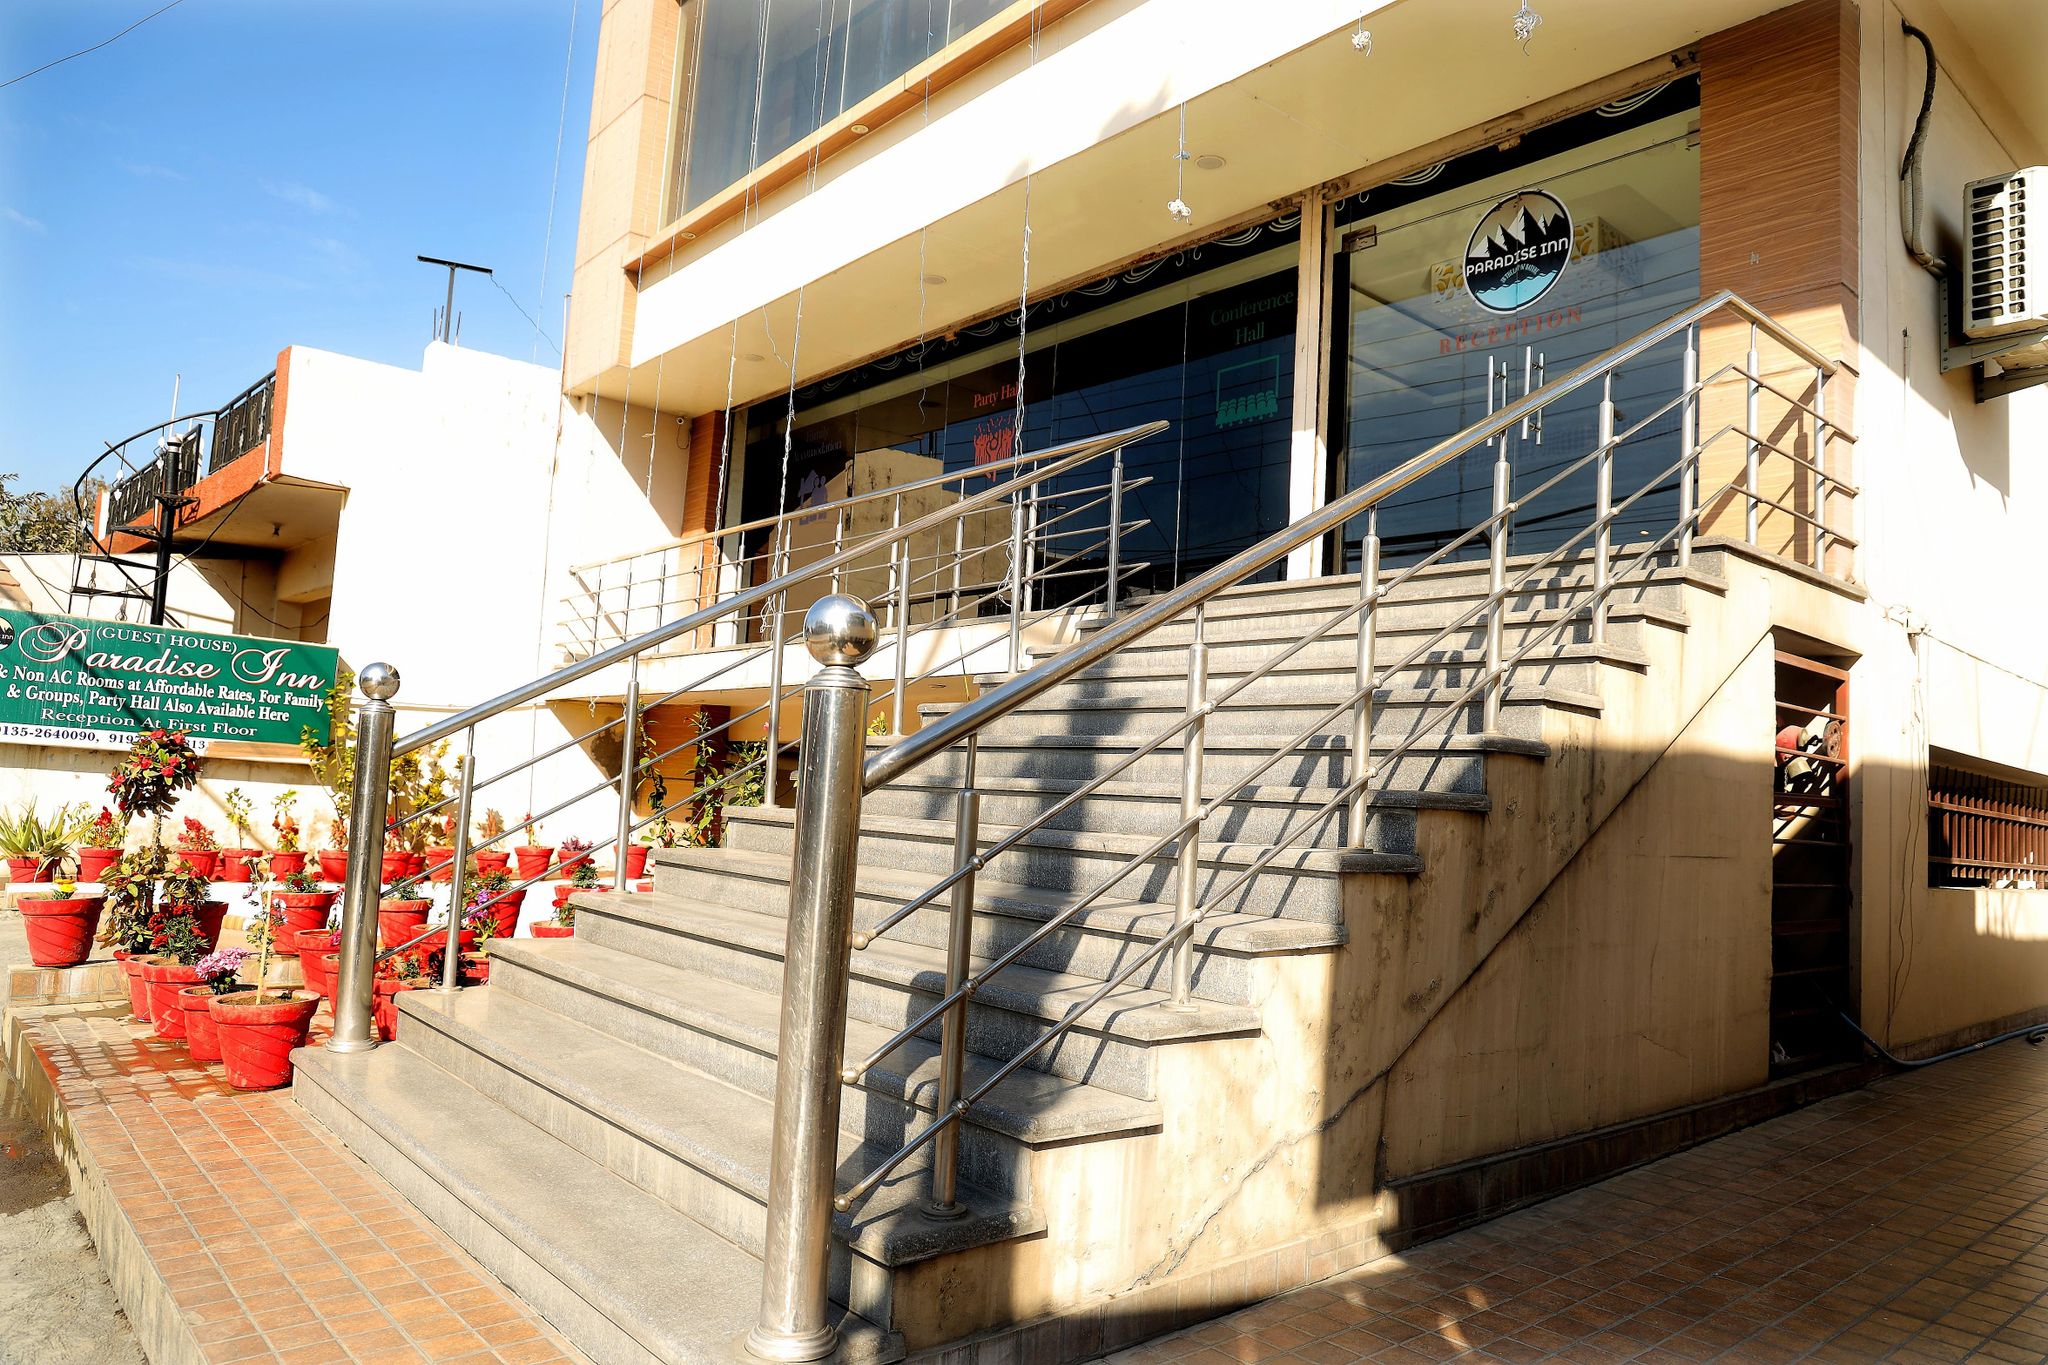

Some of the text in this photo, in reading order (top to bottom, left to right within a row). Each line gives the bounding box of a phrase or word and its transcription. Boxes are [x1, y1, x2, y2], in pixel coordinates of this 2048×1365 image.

[1466, 245, 1537, 277] PARADISE
[1210, 291, 1294, 326] Conference
[1235, 321, 1265, 346] Hall
[1439, 305, 1583, 354] RECEPTION
[973, 381, 1020, 409] Party Hal
[18, 622, 326, 690] Paradise Inn
[96, 626, 238, 655] (GUEST HOUSE)
[6, 683, 290, 722] & Groups, Party Hall Also Available Here
[13, 666, 45, 682] Non
[49, 669, 73, 685] AC
[77, 671, 124, 690] Rooms
[128, 679, 141, 691] at
[144, 678, 215, 698] Affordable
[217, 685, 256, 704] Rates,
[258, 689, 281, 705] For
[283, 691, 325, 713] Family
[0, 726, 100, 743] 135-2640090,
[41, 708, 258, 737] Reception At First Floor
